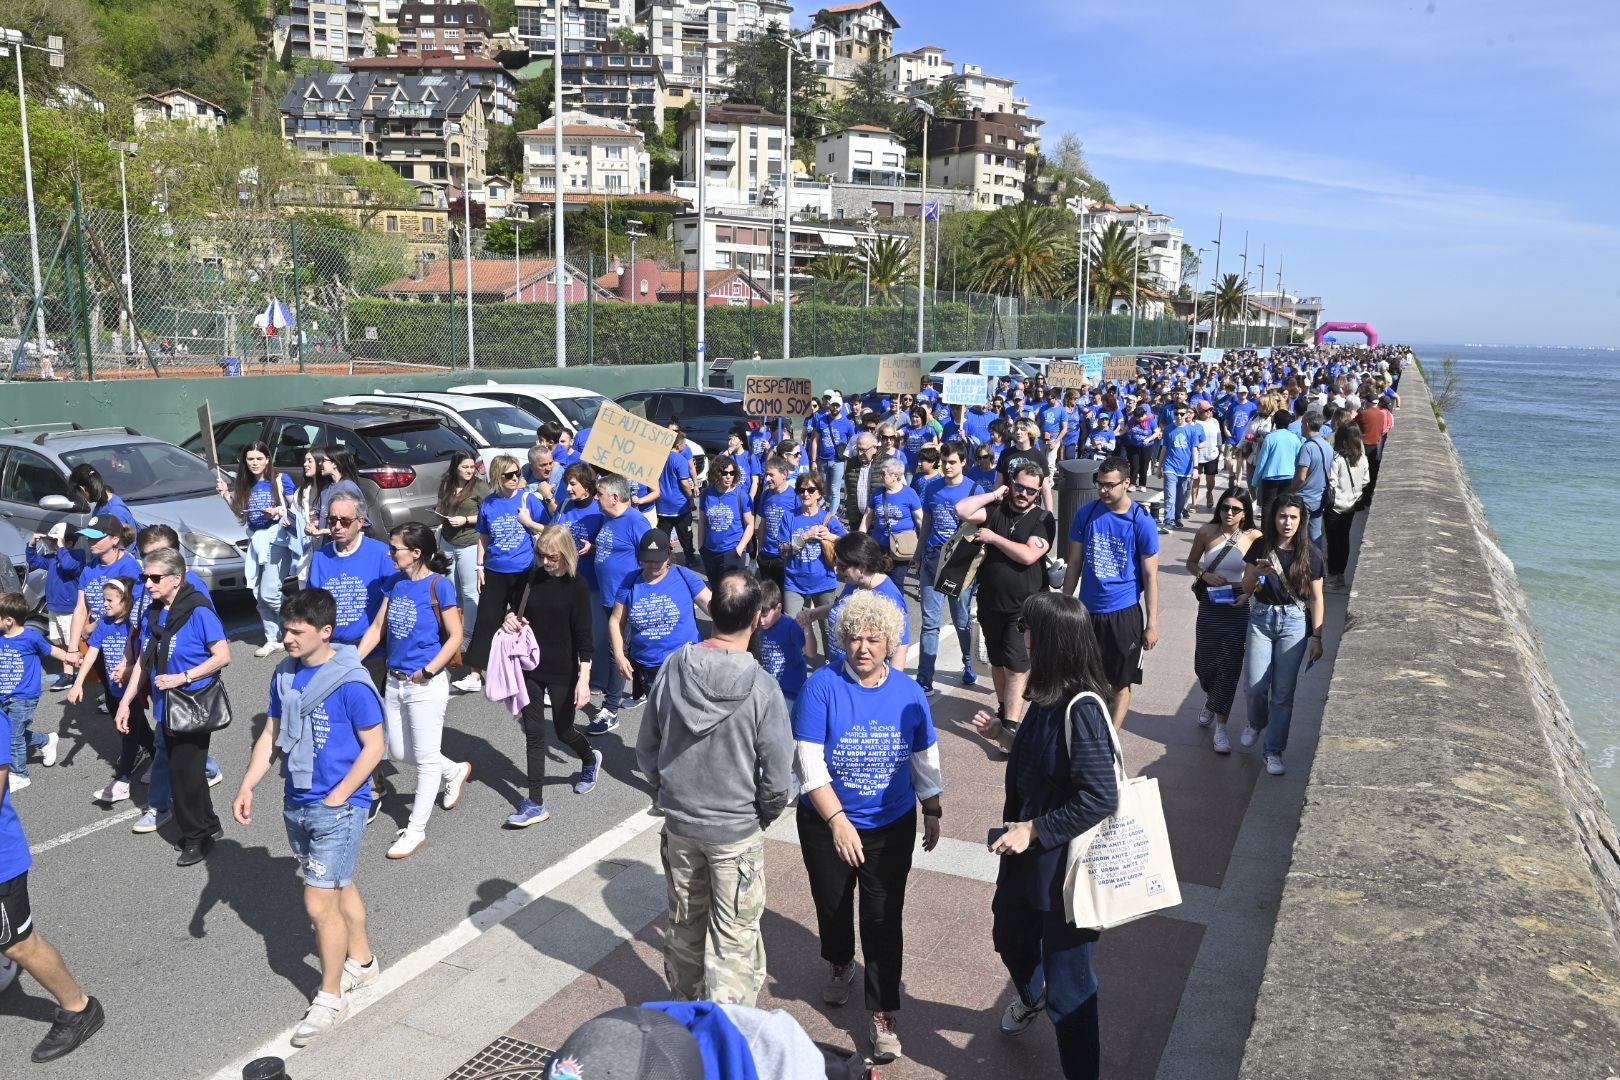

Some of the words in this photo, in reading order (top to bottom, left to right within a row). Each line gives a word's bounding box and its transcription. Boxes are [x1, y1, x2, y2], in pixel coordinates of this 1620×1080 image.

[747, 377, 811, 395] RESPETAME
[747, 398, 782, 415] COMO
[787, 397, 812, 416] SOY
[600, 407, 616, 427] EL
[618, 415, 674, 448] AUTISMO
[610, 434, 636, 454] NO
[592, 446, 612, 465] SE
